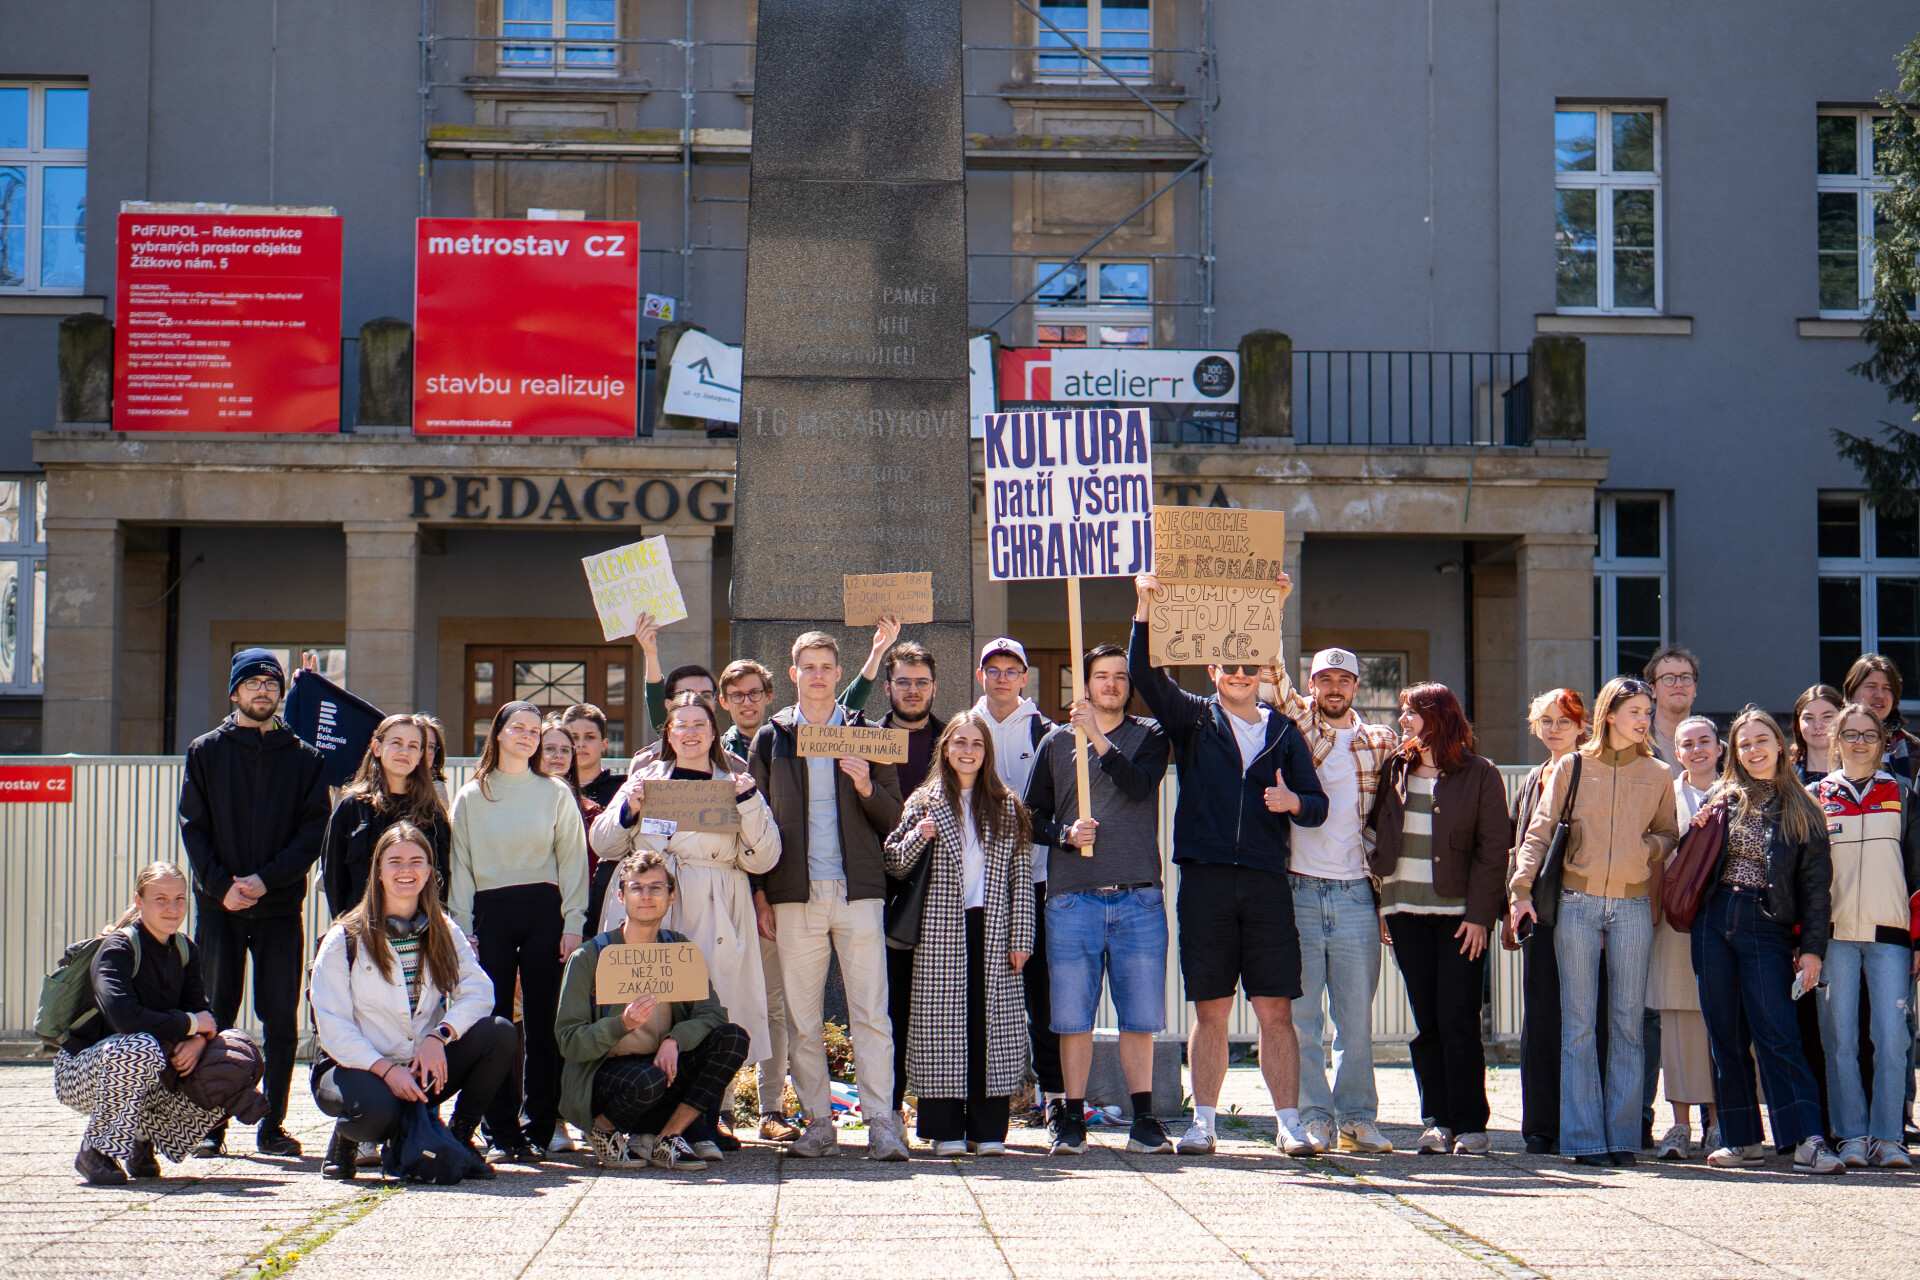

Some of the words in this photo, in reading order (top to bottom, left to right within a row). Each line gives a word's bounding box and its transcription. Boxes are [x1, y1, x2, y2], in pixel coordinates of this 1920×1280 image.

[131, 225, 198, 238] PdF/UPOL
[213, 226, 302, 239] Rekonstrukce
[131, 241, 198, 255] vybraných
[202, 243, 250, 254] prostor
[252, 243, 301, 257] objektu
[428, 234, 570, 255] metrostav
[584, 235, 626, 256] CZ
[131, 254, 181, 268] Žižkovo
[185, 256, 217, 269] nám.
[219, 257, 229, 269] 5
[157, 317, 173, 326] CZ
[426, 373, 511, 394] stavbu
[521, 373, 625, 400] realizuje
[426, 418, 512, 428] www.metrostavdiz.cz
[985, 409, 1148, 469] KULTURA
[408, 475, 732, 522] PEDAGOG
[994, 471, 1054, 524] patří
[1068, 468, 1149, 516] všem
[1155, 511, 1248, 532] NECHCEME
[991, 515, 1120, 578] CHRAŇME
[1128, 512, 1153, 574] JÍ
[1215, 535, 1250, 553] JAK
[1155, 553, 1189, 578] ZA
[1194, 552, 1280, 581] KOMÁRA
[845, 576, 859, 590] UŽ
[863, 578, 870, 588] V
[872, 576, 898, 588] ROCE
[904, 574, 928, 585] 1881
[1152, 583, 1276, 603] OLOMOUC
[603, 611, 627, 635] NA
[1151, 603, 1237, 633] STOJÍ
[1244, 605, 1275, 631] ZA
[1166, 630, 1205, 661] ČT
[318, 724, 333, 734] Prix
[800, 725, 814, 737] ČT
[819, 727, 845, 739] PODLE
[315, 740, 337, 751] Radio
[316, 732, 347, 745] Bohemia
[800, 742, 806, 752] V
[809, 740, 855, 753] ROZPOČTU
[858, 744, 872, 754] JEN
[874, 742, 903, 755] HALÍŘE
[0, 779, 40, 790] rostav
[46, 779, 66, 790] CZ
[695, 782, 706, 792] BY
[609, 948, 671, 965] SLEDUJTE
[678, 946, 694, 963] ČT
[631, 965, 653, 978] NEŽ
[660, 966, 673, 977] TO
[618, 977, 674, 994] ZAKÁŽOU
